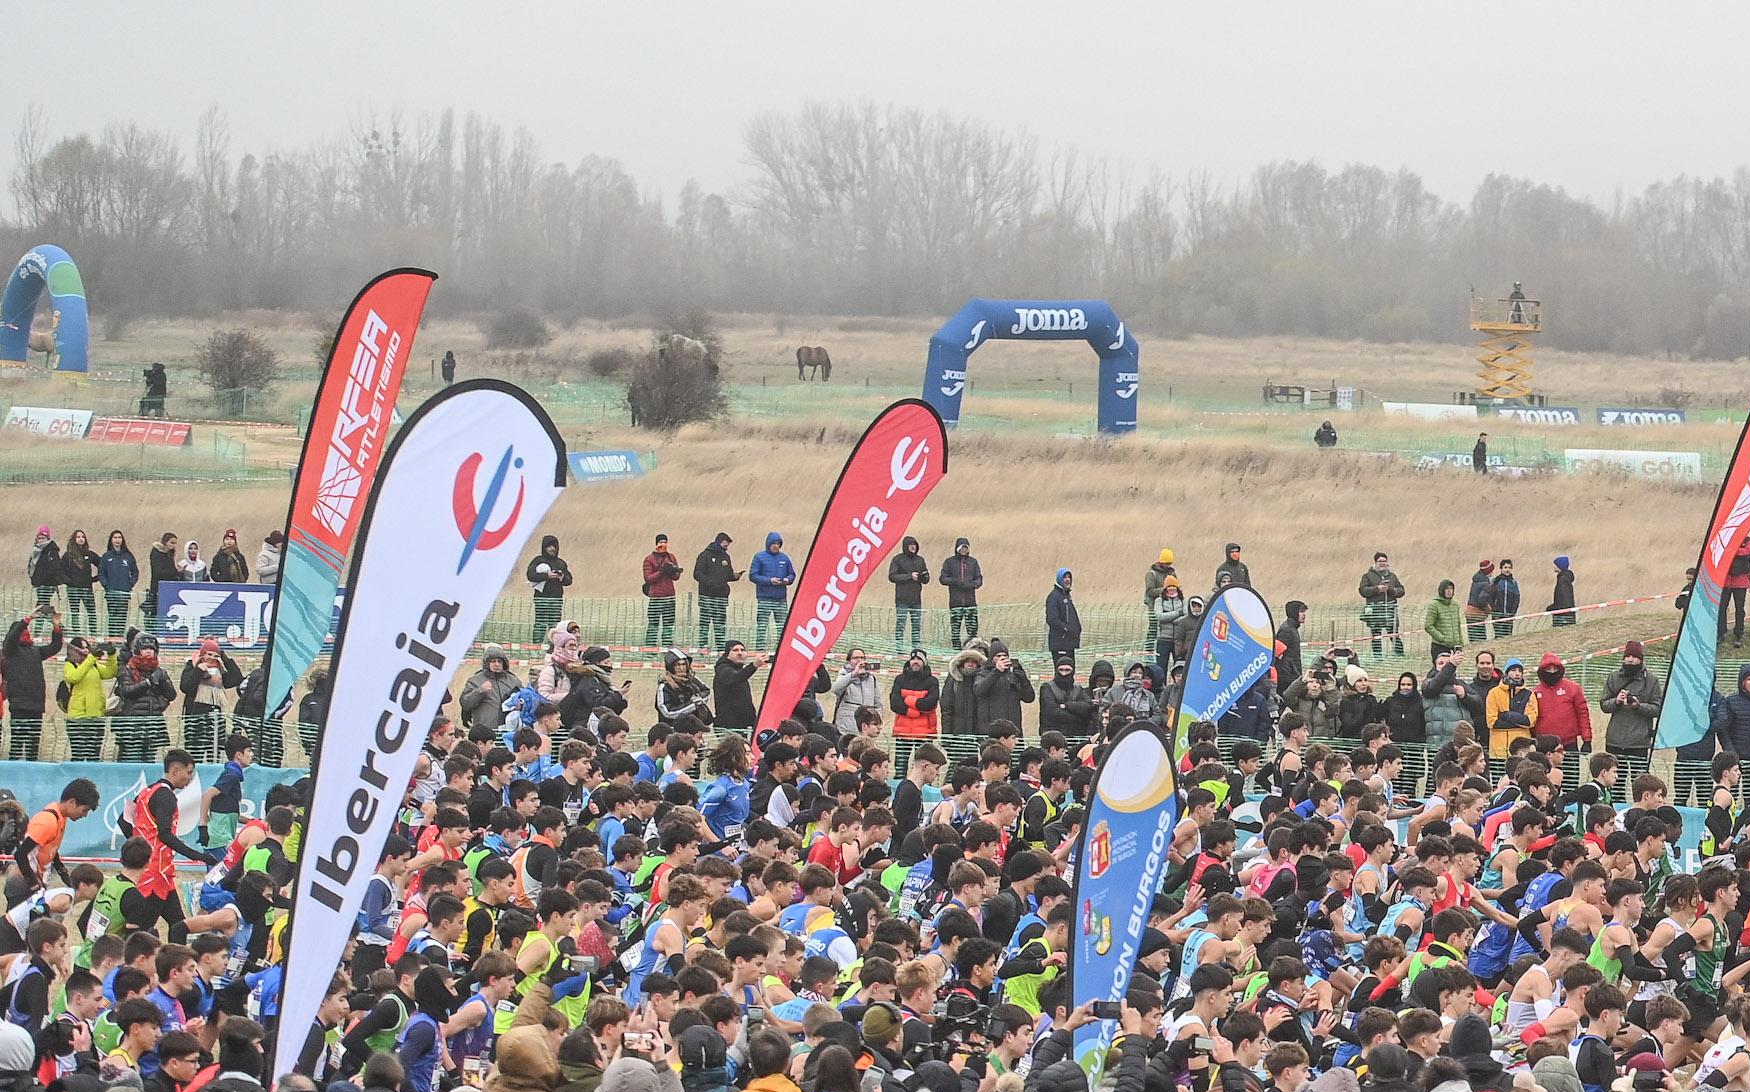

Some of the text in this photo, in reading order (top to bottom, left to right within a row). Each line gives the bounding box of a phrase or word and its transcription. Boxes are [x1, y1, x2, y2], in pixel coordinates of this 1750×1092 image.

[331, 308, 388, 459] RFEA
[356, 331, 401, 469] ATLETISMO
[790, 502, 887, 661] Ibercaja
[1229, 652, 1268, 693] BURGOS
[309, 597, 464, 914] Ibercaja
[1127, 810, 1171, 940] BURGOS
